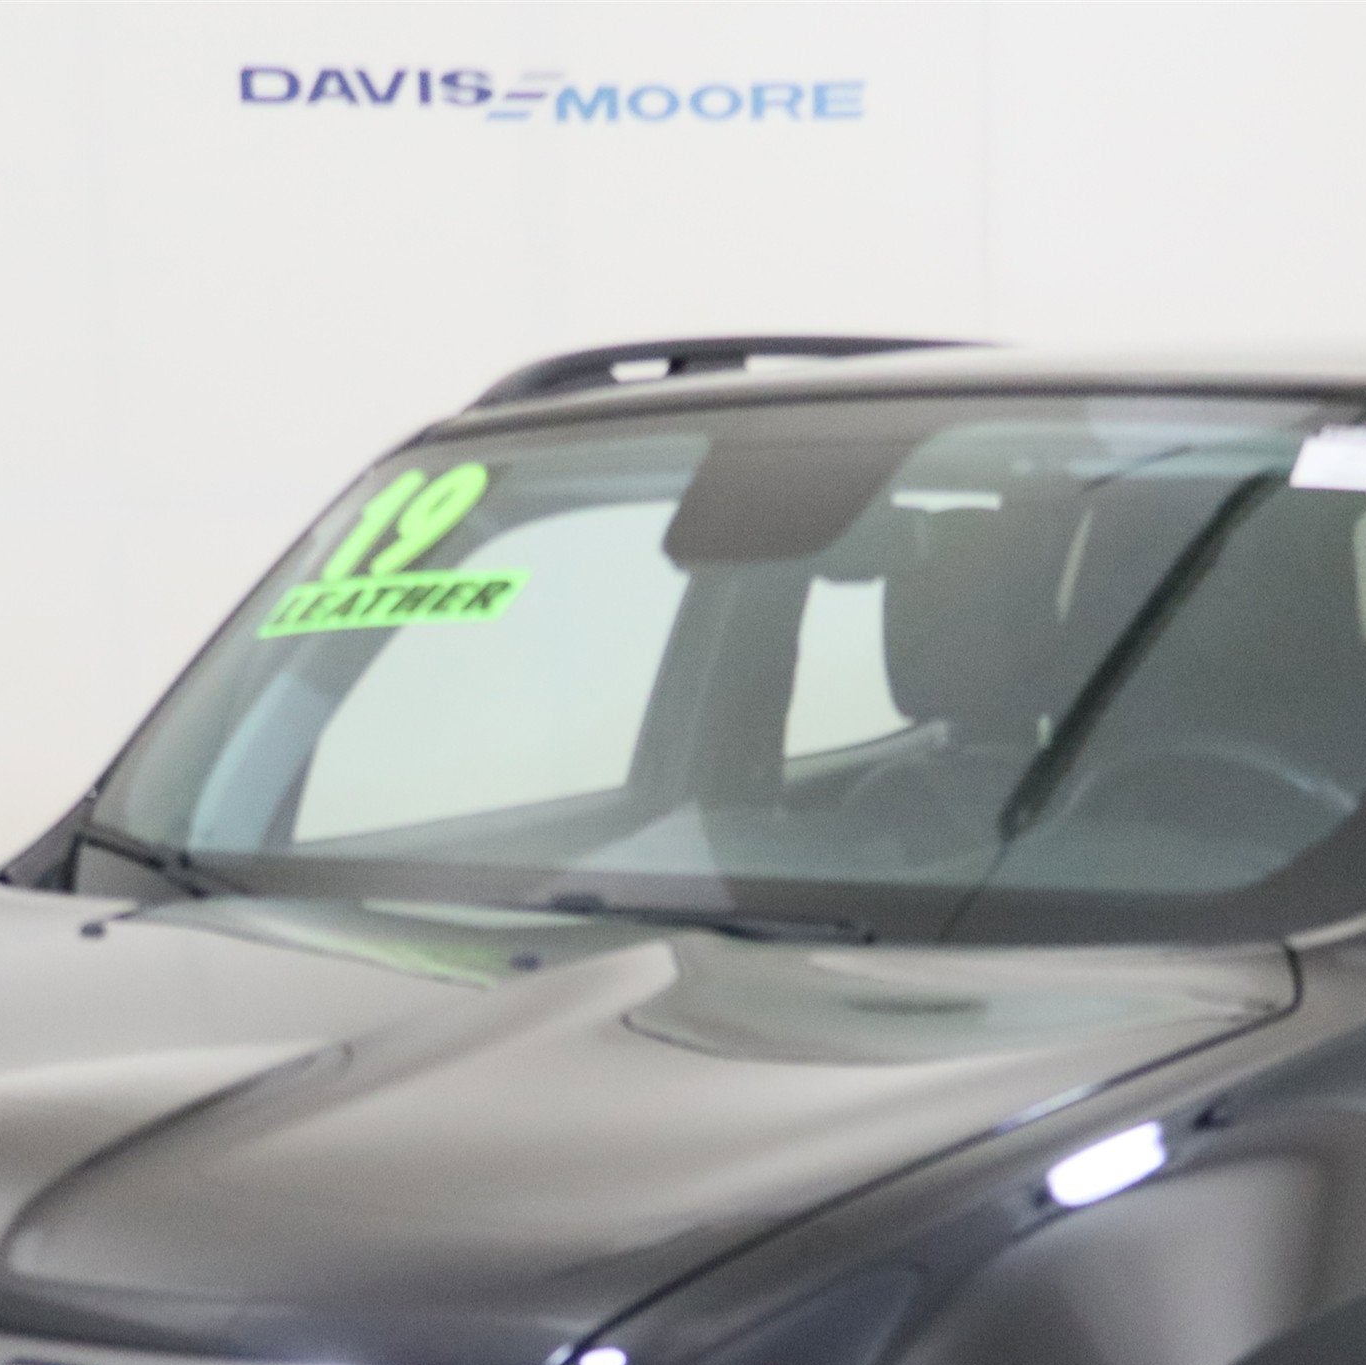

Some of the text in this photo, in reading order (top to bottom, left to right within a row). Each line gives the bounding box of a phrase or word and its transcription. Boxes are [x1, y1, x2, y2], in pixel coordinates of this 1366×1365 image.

[238, 65, 865, 122] DAVIS MOORE
[322, 461, 487, 580] 19
[269, 578, 513, 626] LEATHER
